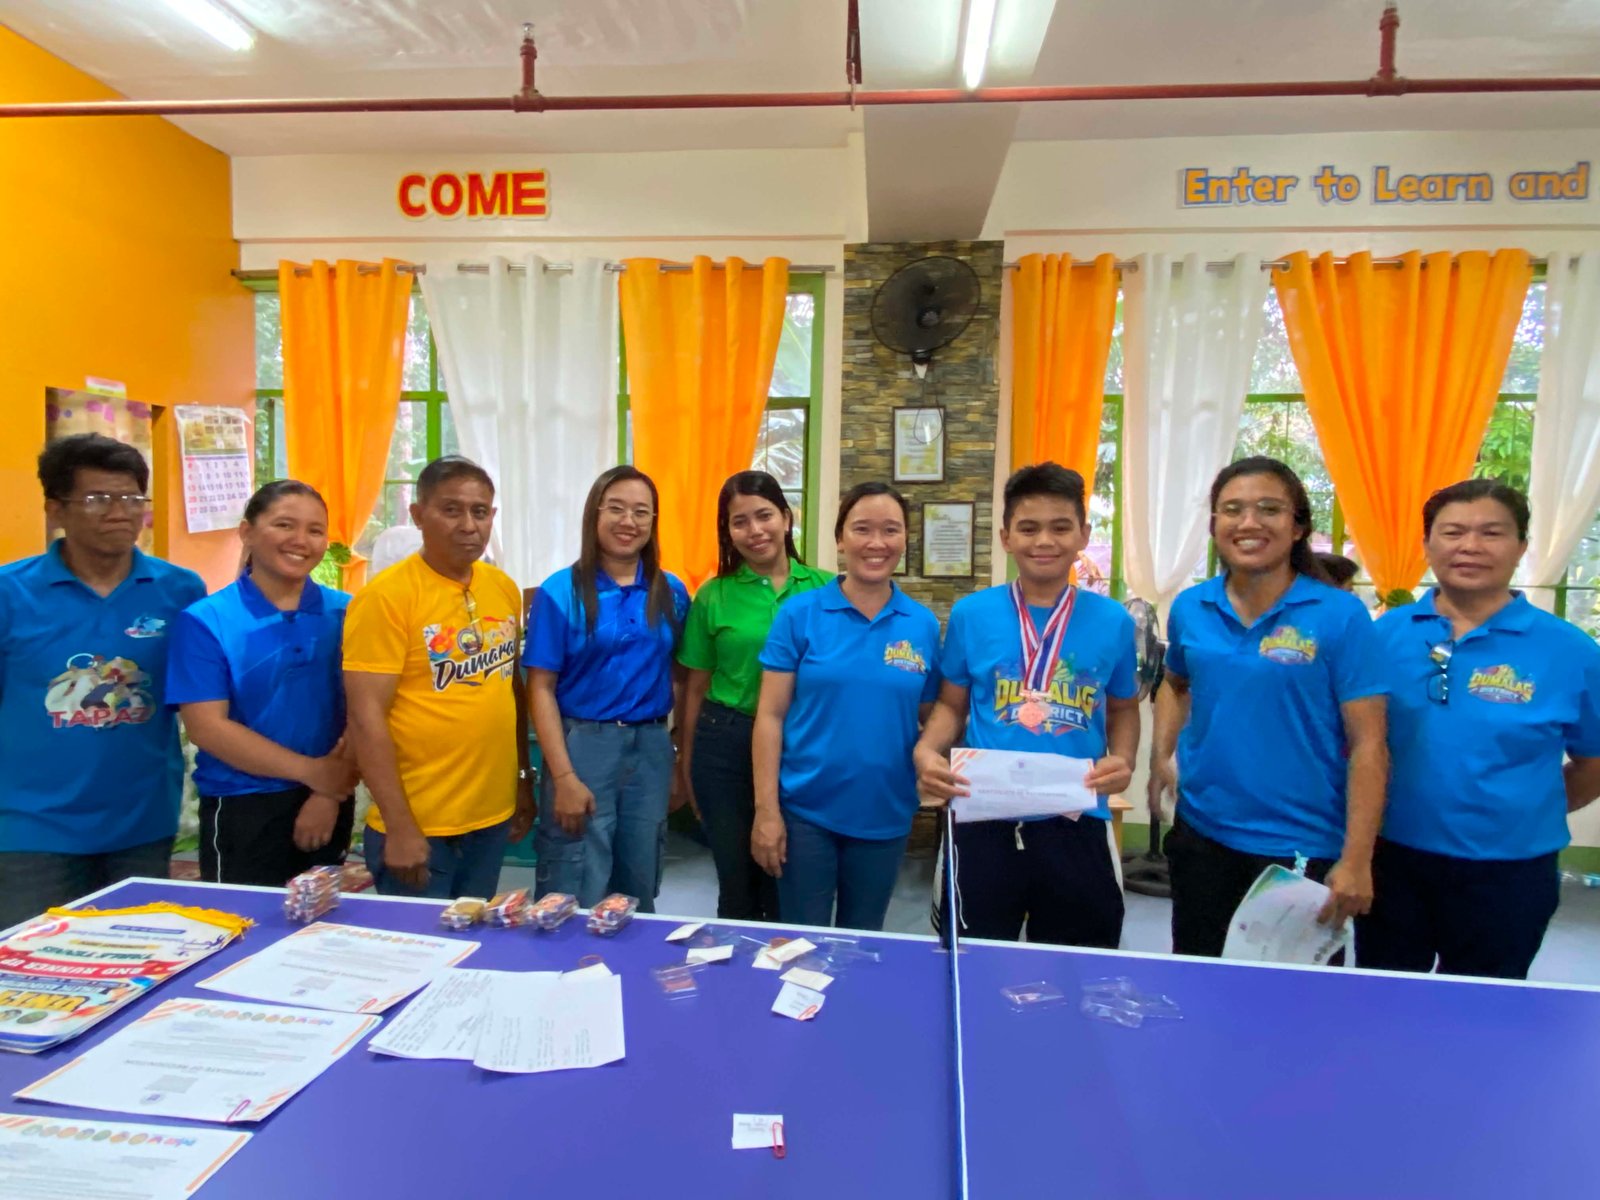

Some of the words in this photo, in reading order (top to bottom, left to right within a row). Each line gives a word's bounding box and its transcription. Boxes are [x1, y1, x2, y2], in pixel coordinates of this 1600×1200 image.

[398, 170, 547, 218] COME
[1183, 166, 1299, 204] Enter
[1314, 165, 1360, 202] to
[1373, 166, 1494, 203] Learn
[1509, 161, 1591, 201] and
[0, 957, 26, 968] UP
[23, 962, 96, 976] RUNNER
